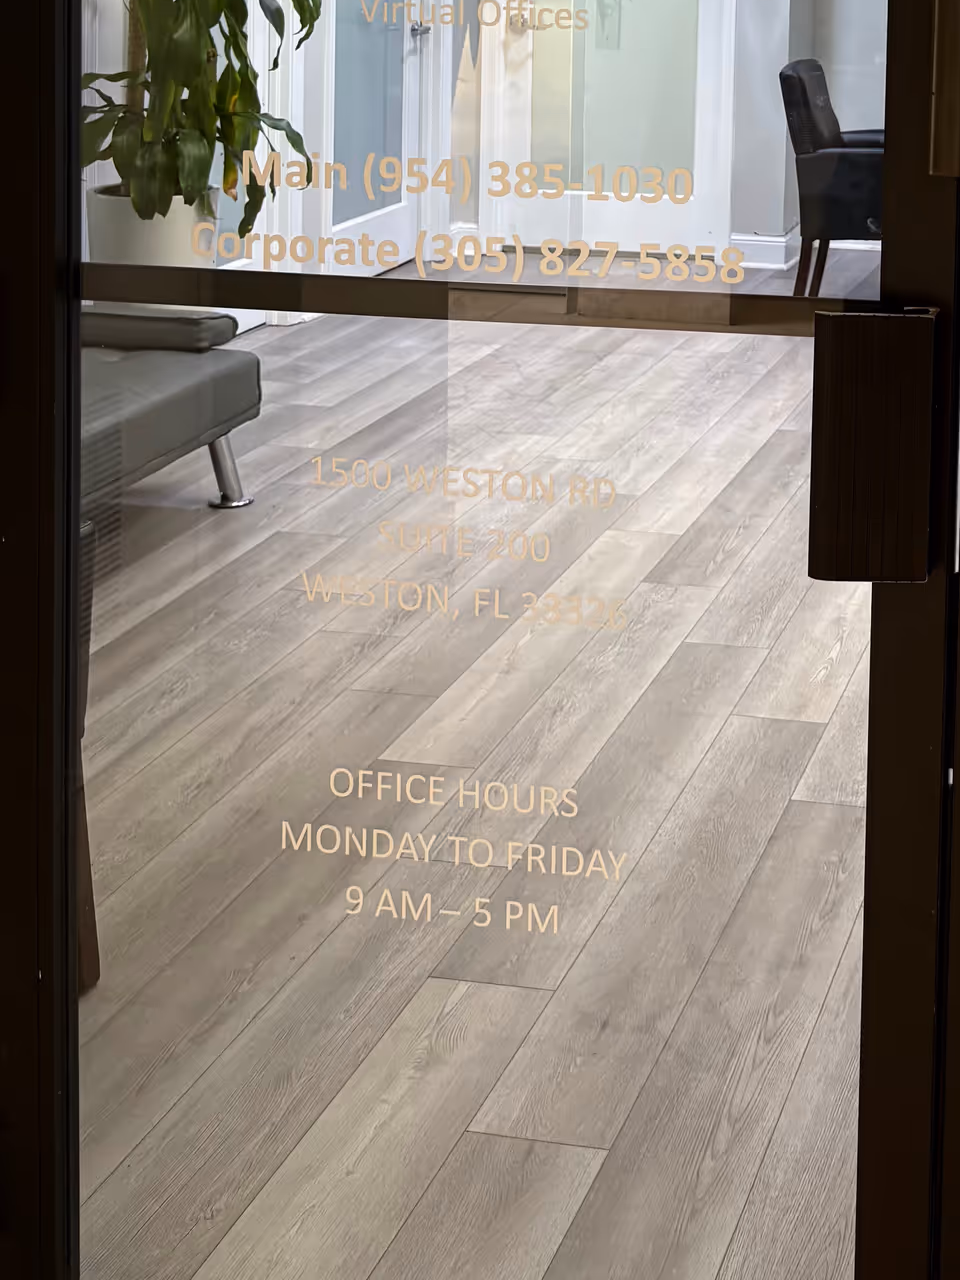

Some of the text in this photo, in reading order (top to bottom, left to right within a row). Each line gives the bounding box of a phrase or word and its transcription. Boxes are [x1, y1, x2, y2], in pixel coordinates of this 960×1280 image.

[242, 149, 694, 205] Main (954) 385-1030
[191, 222, 746, 285] Corporate (305) 827-5858
[310, 456, 616, 508] 1500 WESTON RD
[377, 521, 551, 562] SUITE 200
[302, 573, 460, 621] WESTON,
[474, 588, 510, 619] FL
[329, 768, 579, 818] OFFICE HOURS
[280, 821, 627, 881] MONDAY TO FRIDAY
[345, 885, 364, 914] 9
[375, 888, 432, 922] AM
[473, 897, 492, 927] 5
[505, 900, 559, 934] PM
